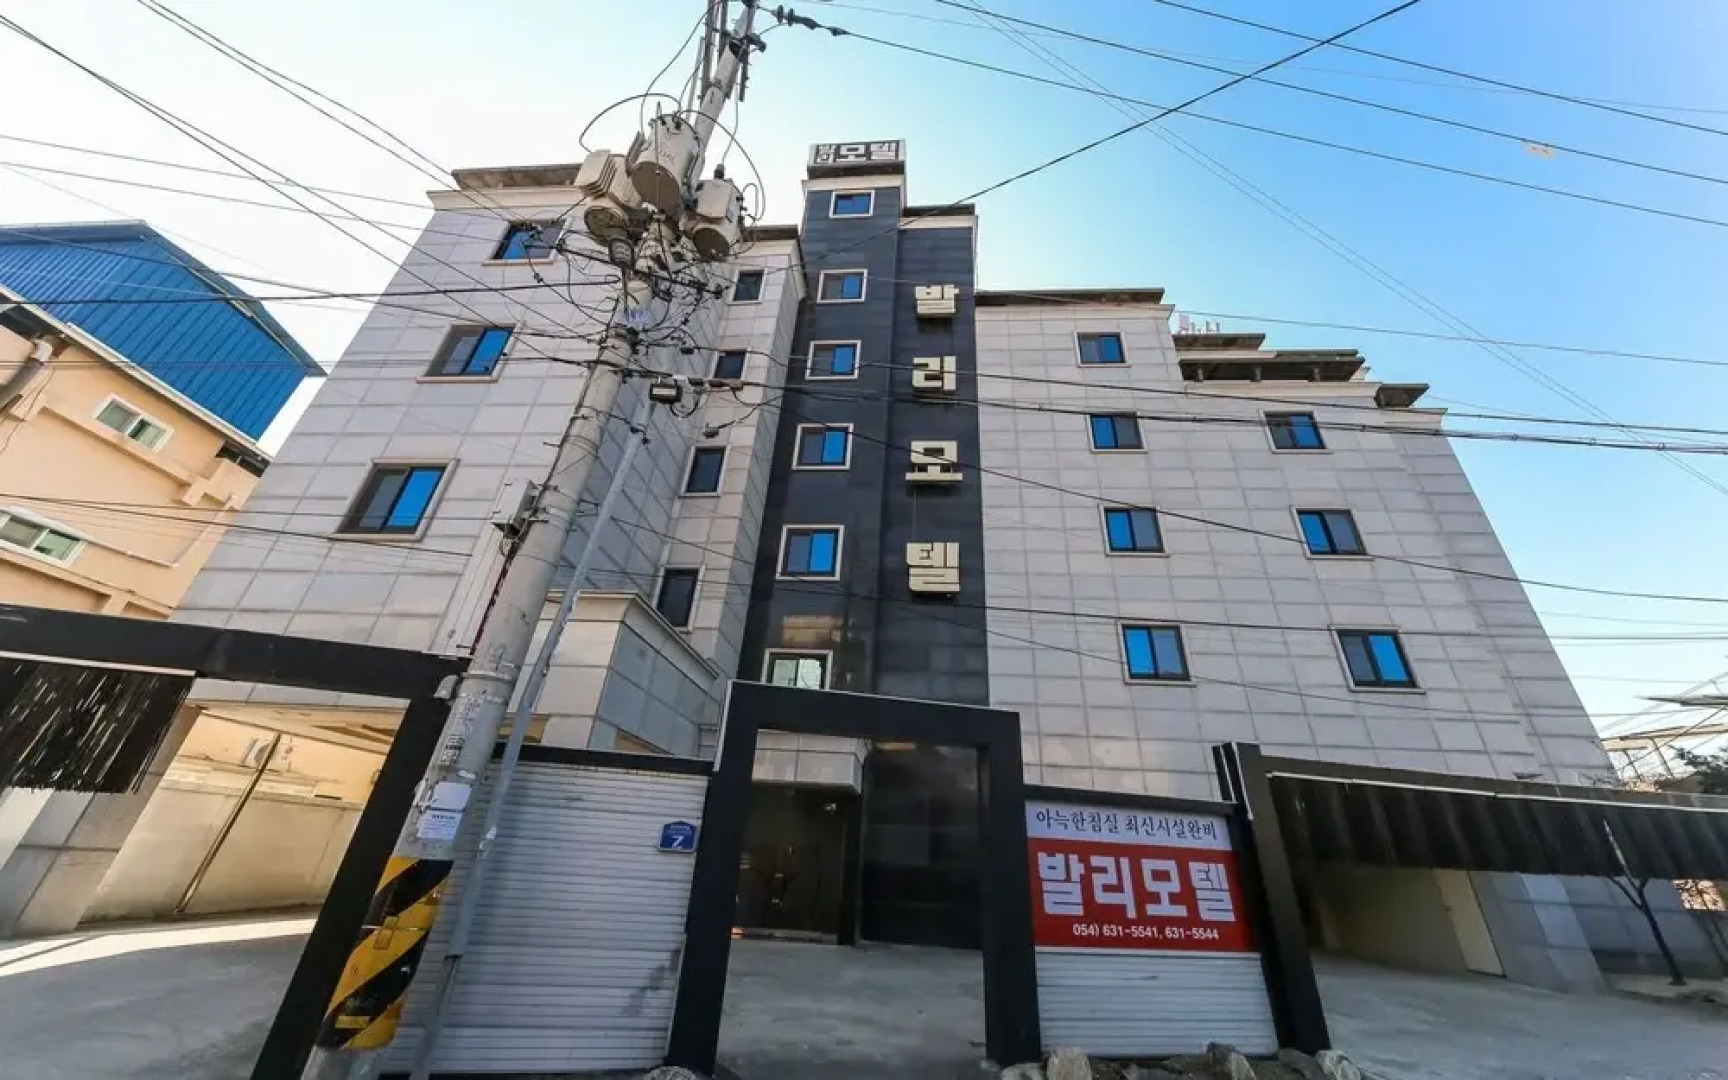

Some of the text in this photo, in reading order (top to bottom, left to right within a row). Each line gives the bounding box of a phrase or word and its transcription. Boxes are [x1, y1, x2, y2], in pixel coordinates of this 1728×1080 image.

[905, 284, 963, 592] 발리모텔
[1036, 808, 1217, 841] 아늑한침실 최신시설완비
[1037, 851, 1237, 922] 발리모텔
[1072, 923, 1219, 940] 054) 631-5541, 631-5544
